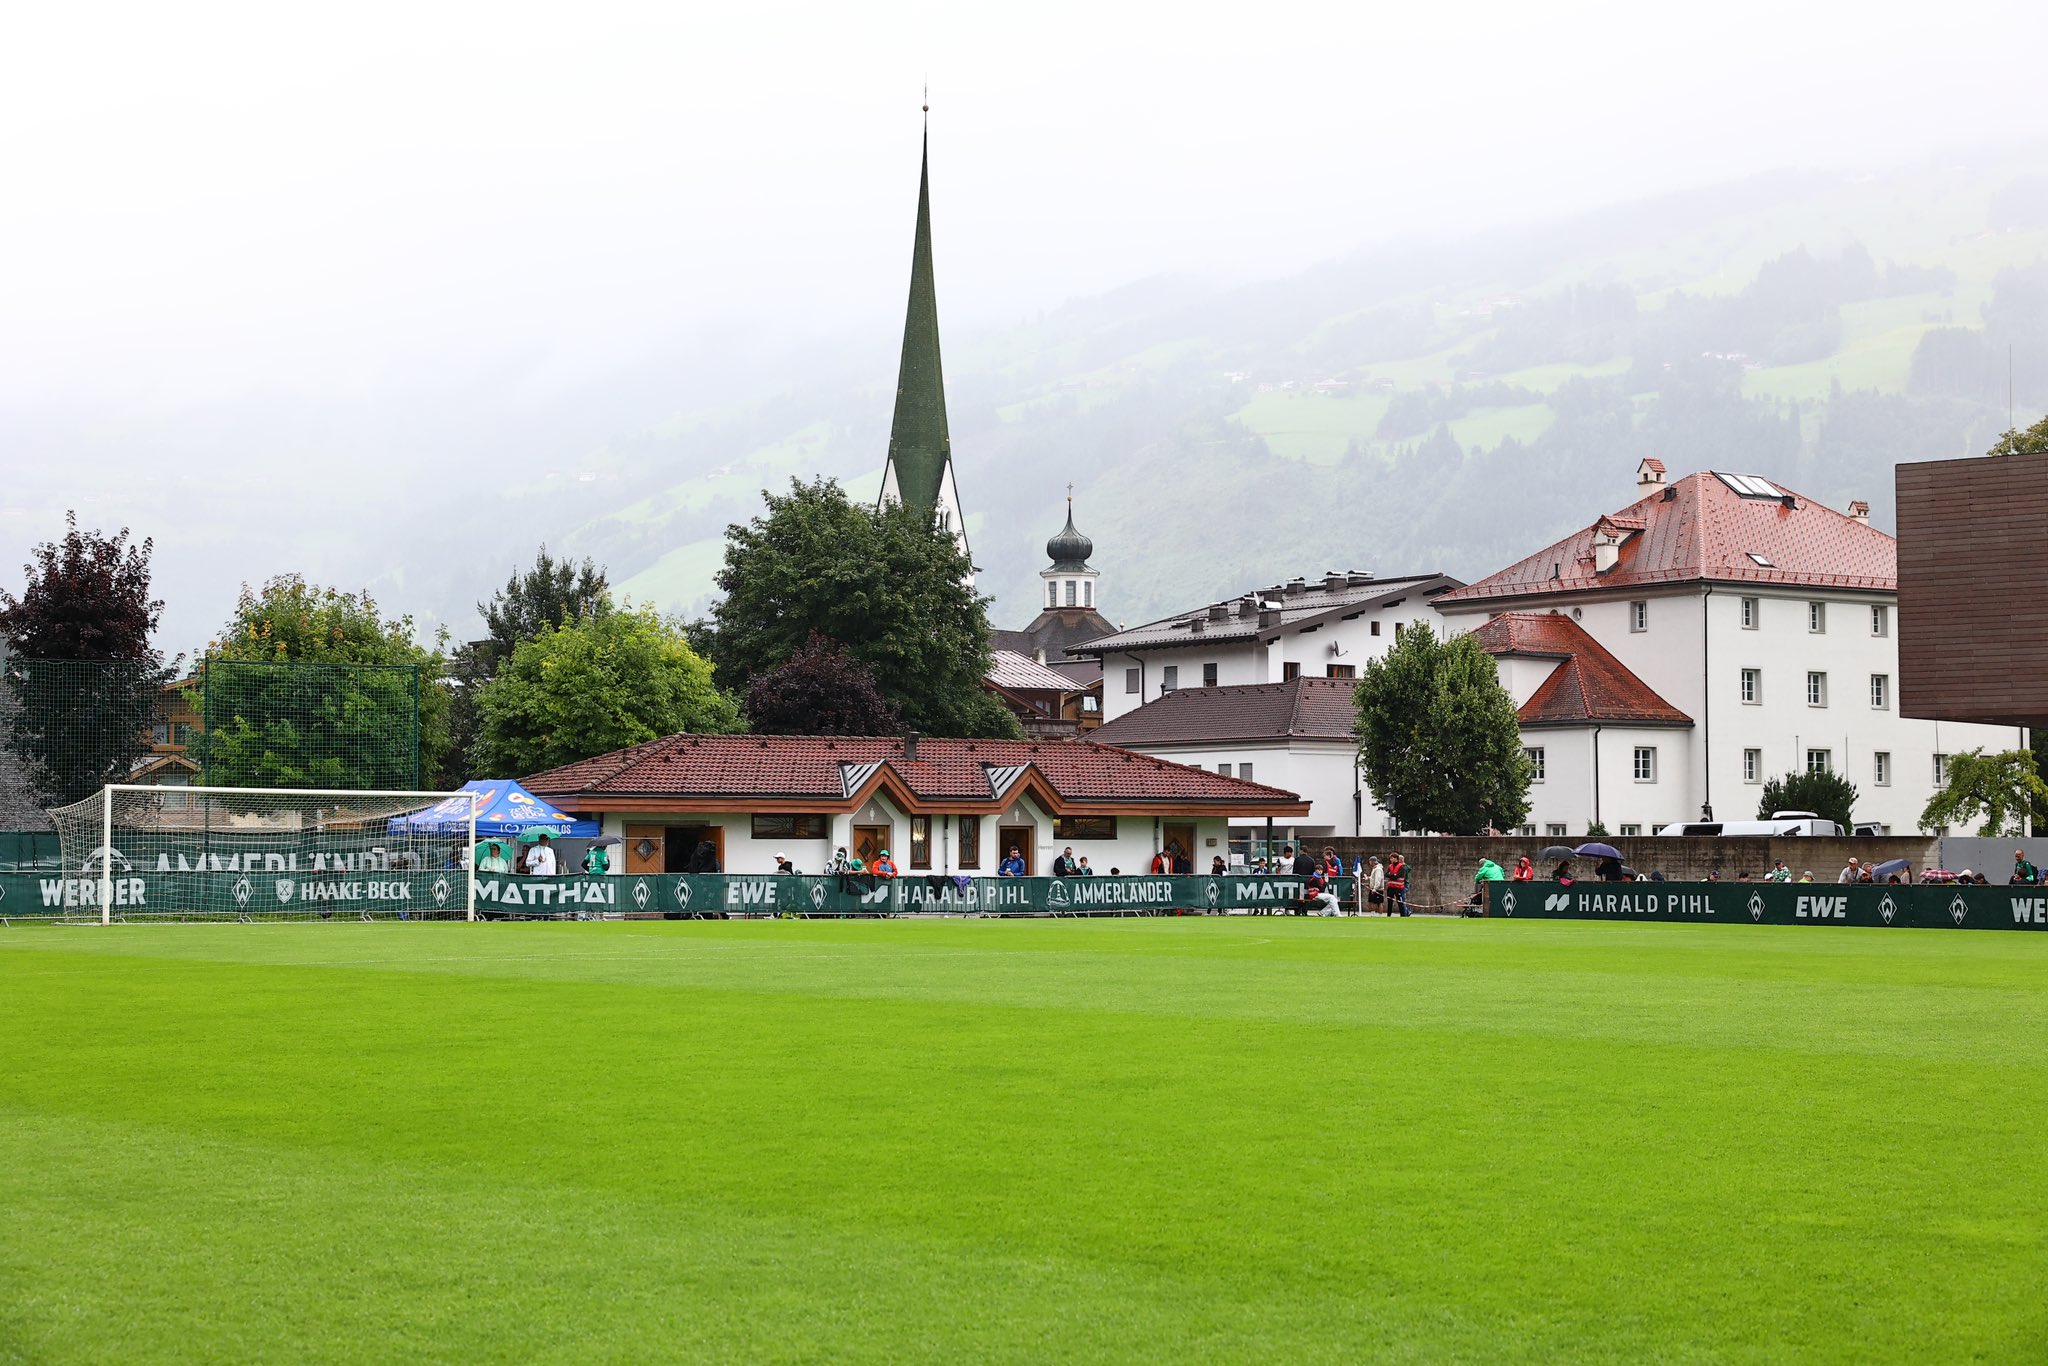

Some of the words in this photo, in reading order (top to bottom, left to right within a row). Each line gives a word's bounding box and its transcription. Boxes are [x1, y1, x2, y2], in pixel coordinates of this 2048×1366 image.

[301, 881, 412, 900] HAAKE-BECK
[473, 879, 614, 904] MATTHÄI
[727, 882, 777, 904] EWE
[897, 885, 978, 905] HARALD
[986, 885, 1029, 905] PIHL
[1073, 882, 1172, 904] AMMERLÄNDER
[1579, 894, 1659, 913] HARALD
[1667, 895, 1715, 914] PIHL
[1795, 896, 1847, 919] EWE
[2010, 897, 2048, 923] WE
